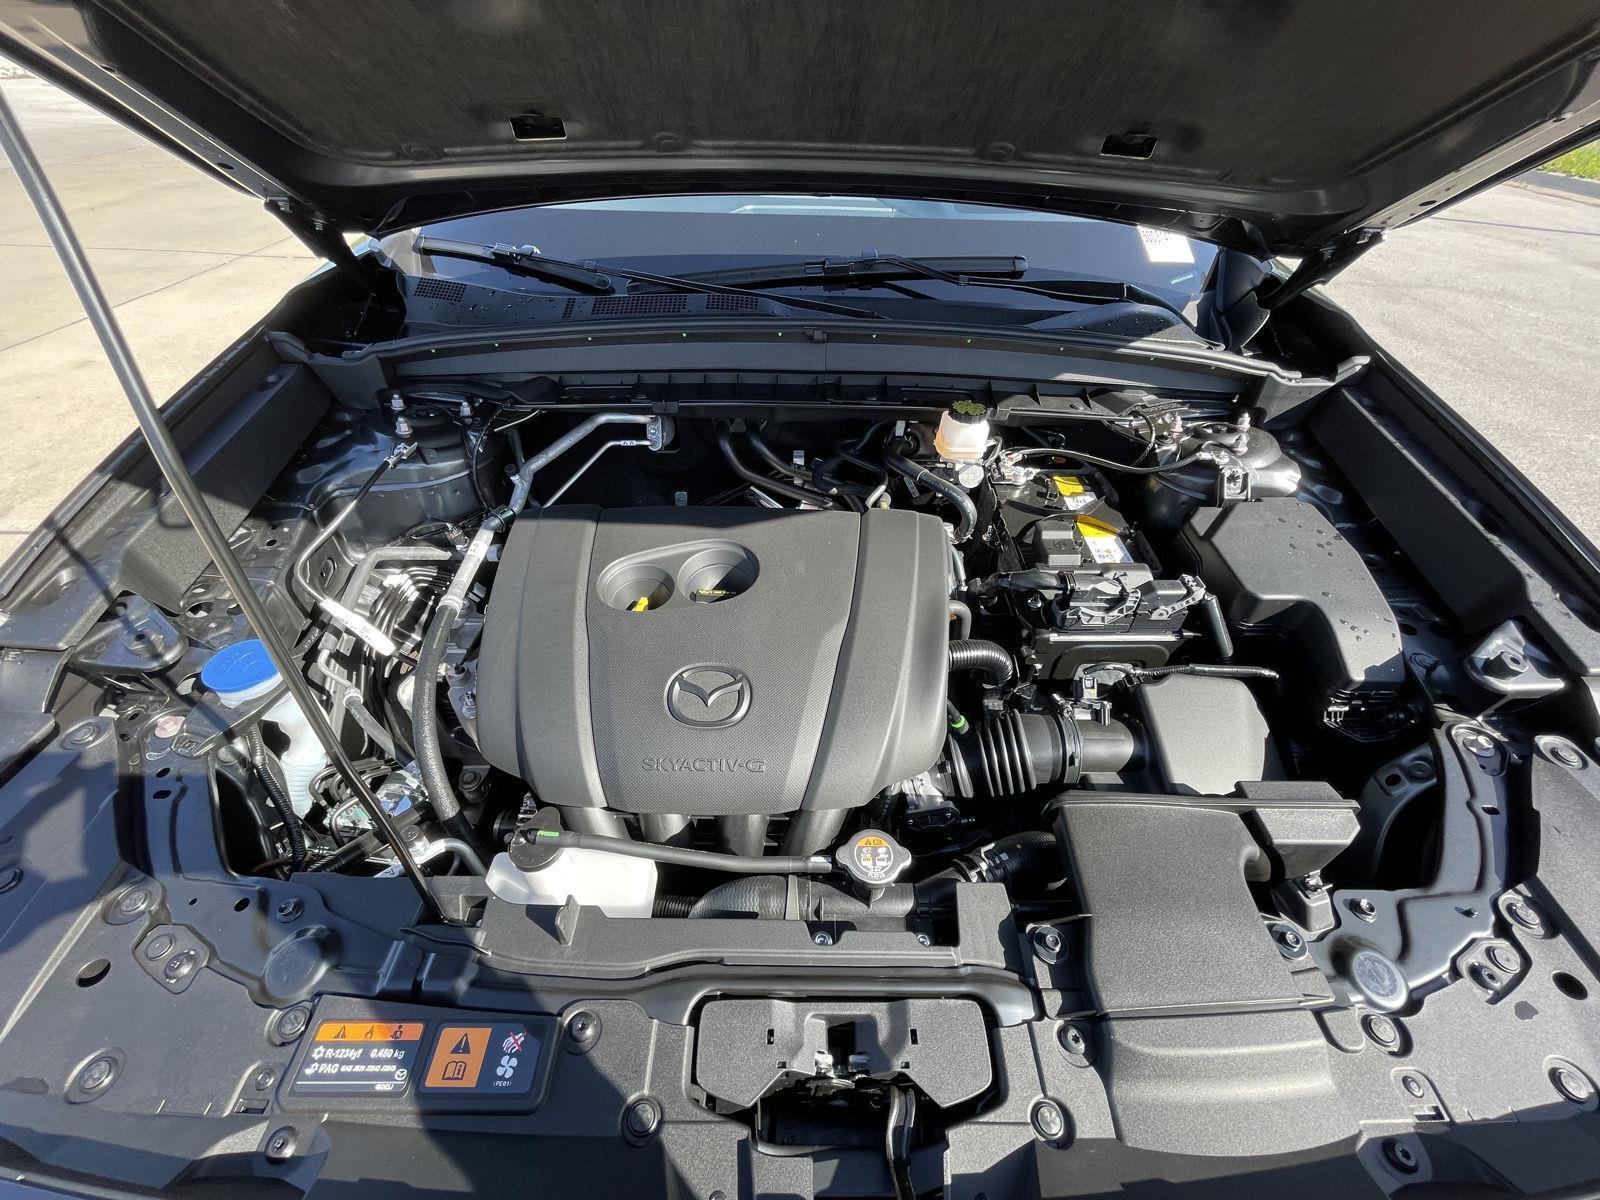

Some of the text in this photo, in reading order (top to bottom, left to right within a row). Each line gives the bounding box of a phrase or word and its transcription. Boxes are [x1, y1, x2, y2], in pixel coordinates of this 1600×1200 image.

[641, 757, 765, 773] SKYACTIV-G
[393, 1048, 405, 1060] kg
[318, 1063, 340, 1074] PAG
